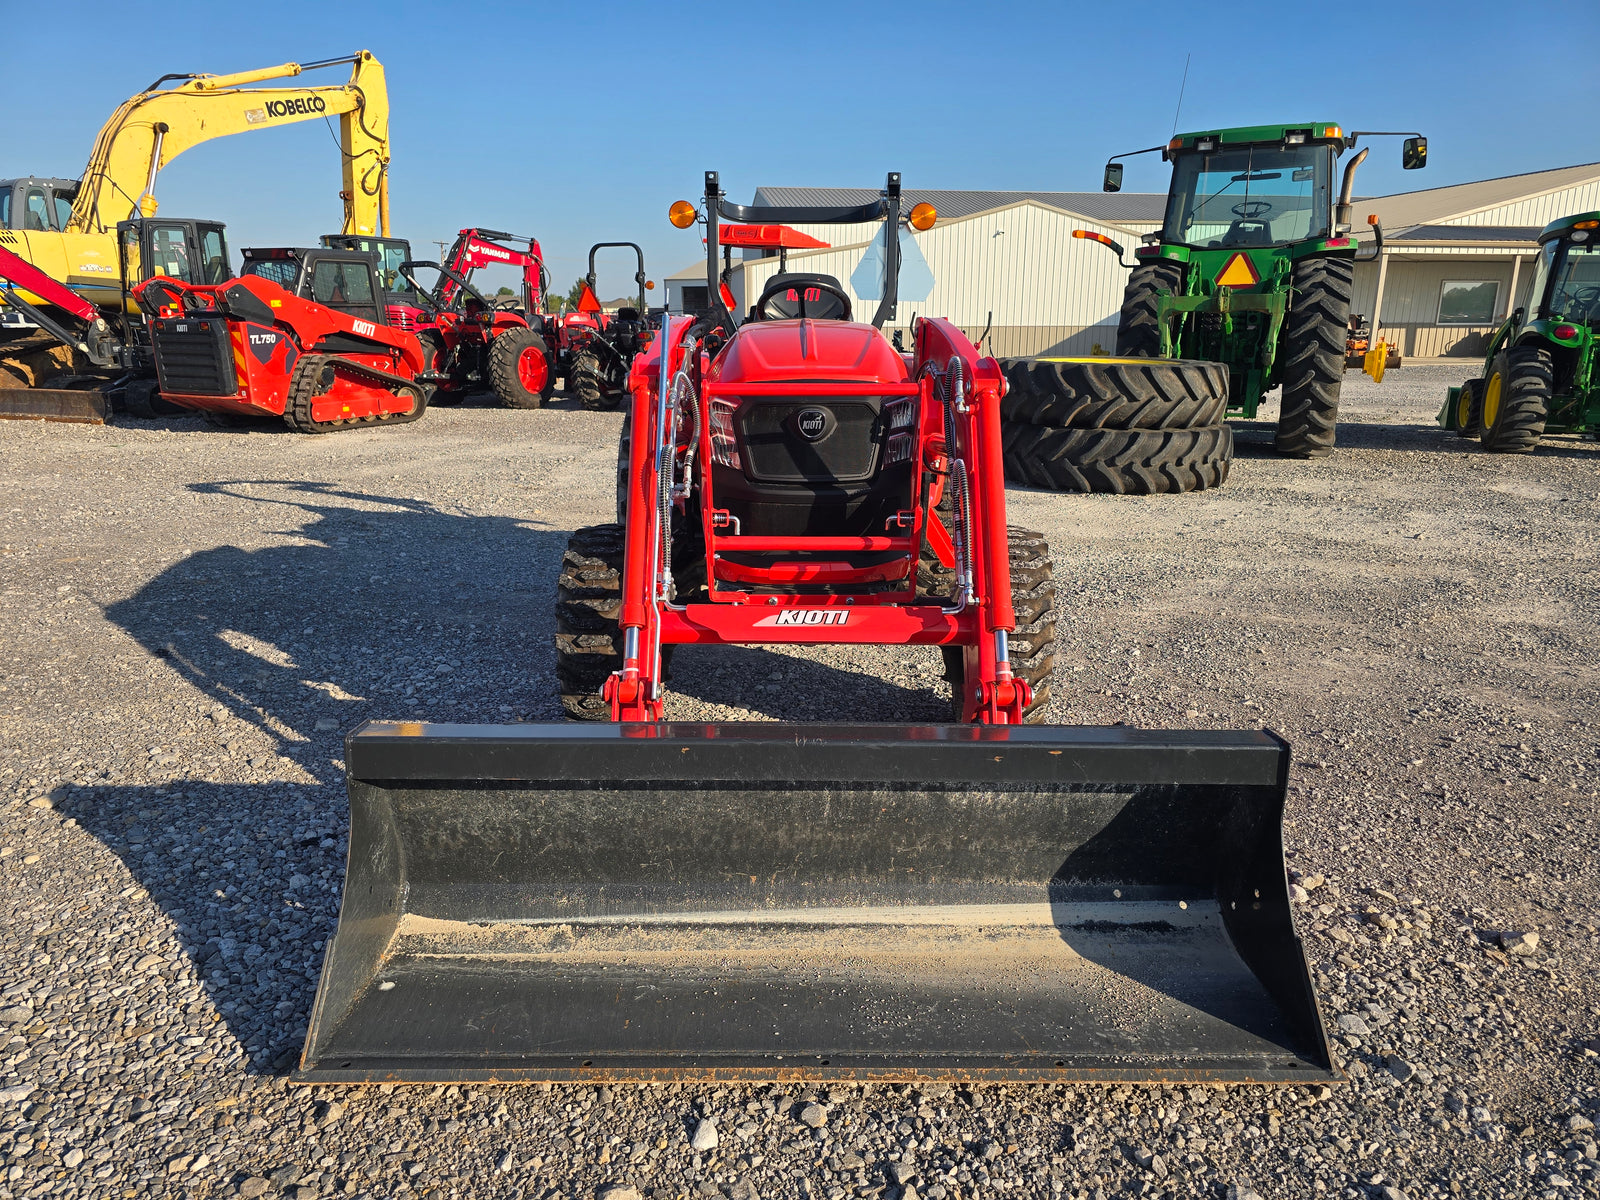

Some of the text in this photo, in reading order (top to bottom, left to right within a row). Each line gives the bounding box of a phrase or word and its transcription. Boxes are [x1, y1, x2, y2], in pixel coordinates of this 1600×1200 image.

[265, 96, 326, 118] KOBELCO
[480, 246, 510, 260] YANMAR
[176, 324, 188, 332] KIOTI
[352, 319, 376, 337] KIOTI
[249, 334, 276, 344] TL750
[802, 420, 823, 430] KIOTI
[776, 610, 850, 625] KIOTI
